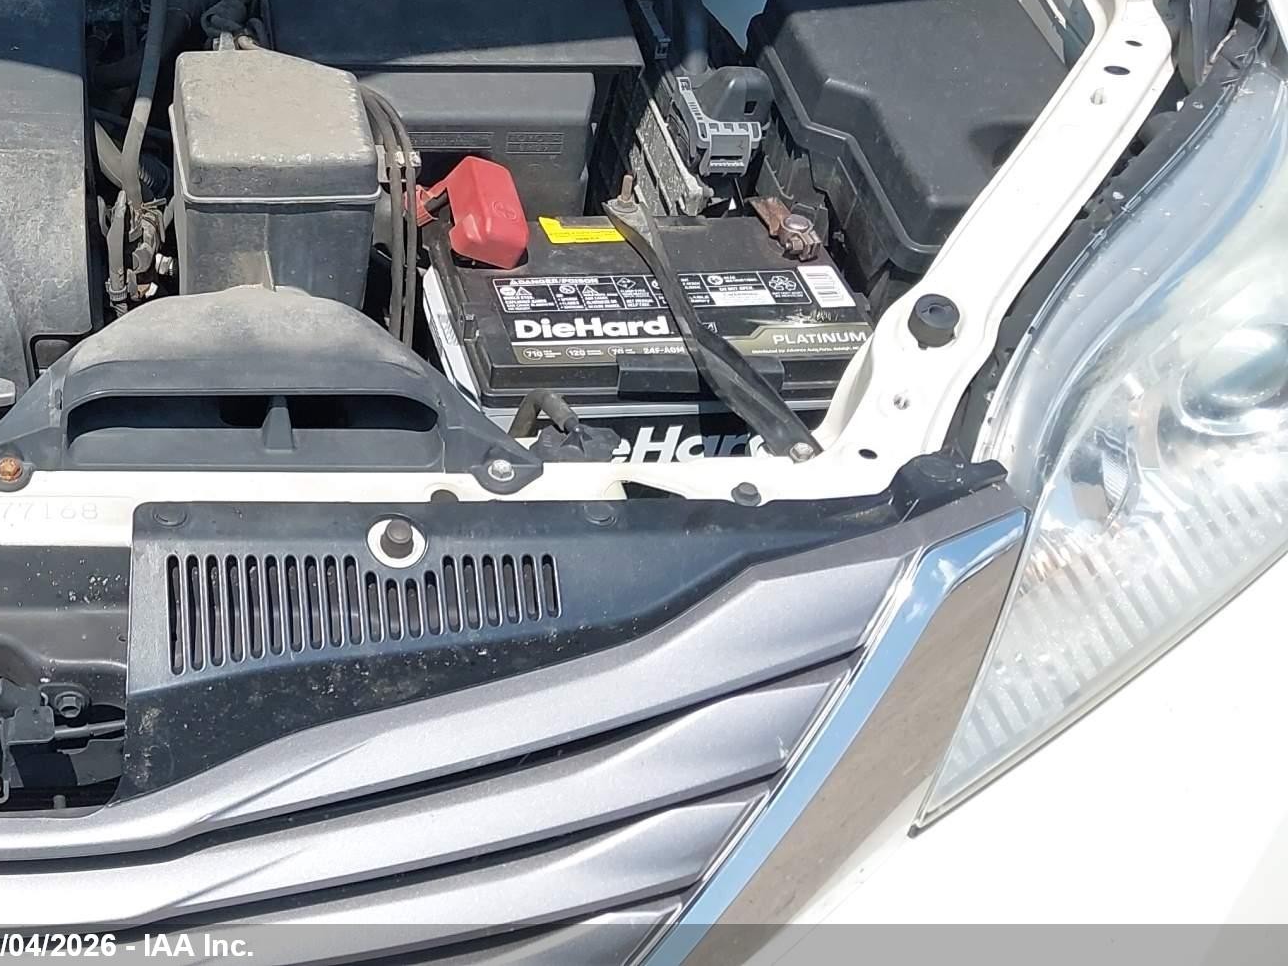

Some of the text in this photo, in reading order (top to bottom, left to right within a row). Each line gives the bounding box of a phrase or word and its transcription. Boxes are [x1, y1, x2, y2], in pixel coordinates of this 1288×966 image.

[514, 315, 670, 339] DieHard
[772, 331, 867, 345] PLATINUM
[526, 349, 542, 358] 710
